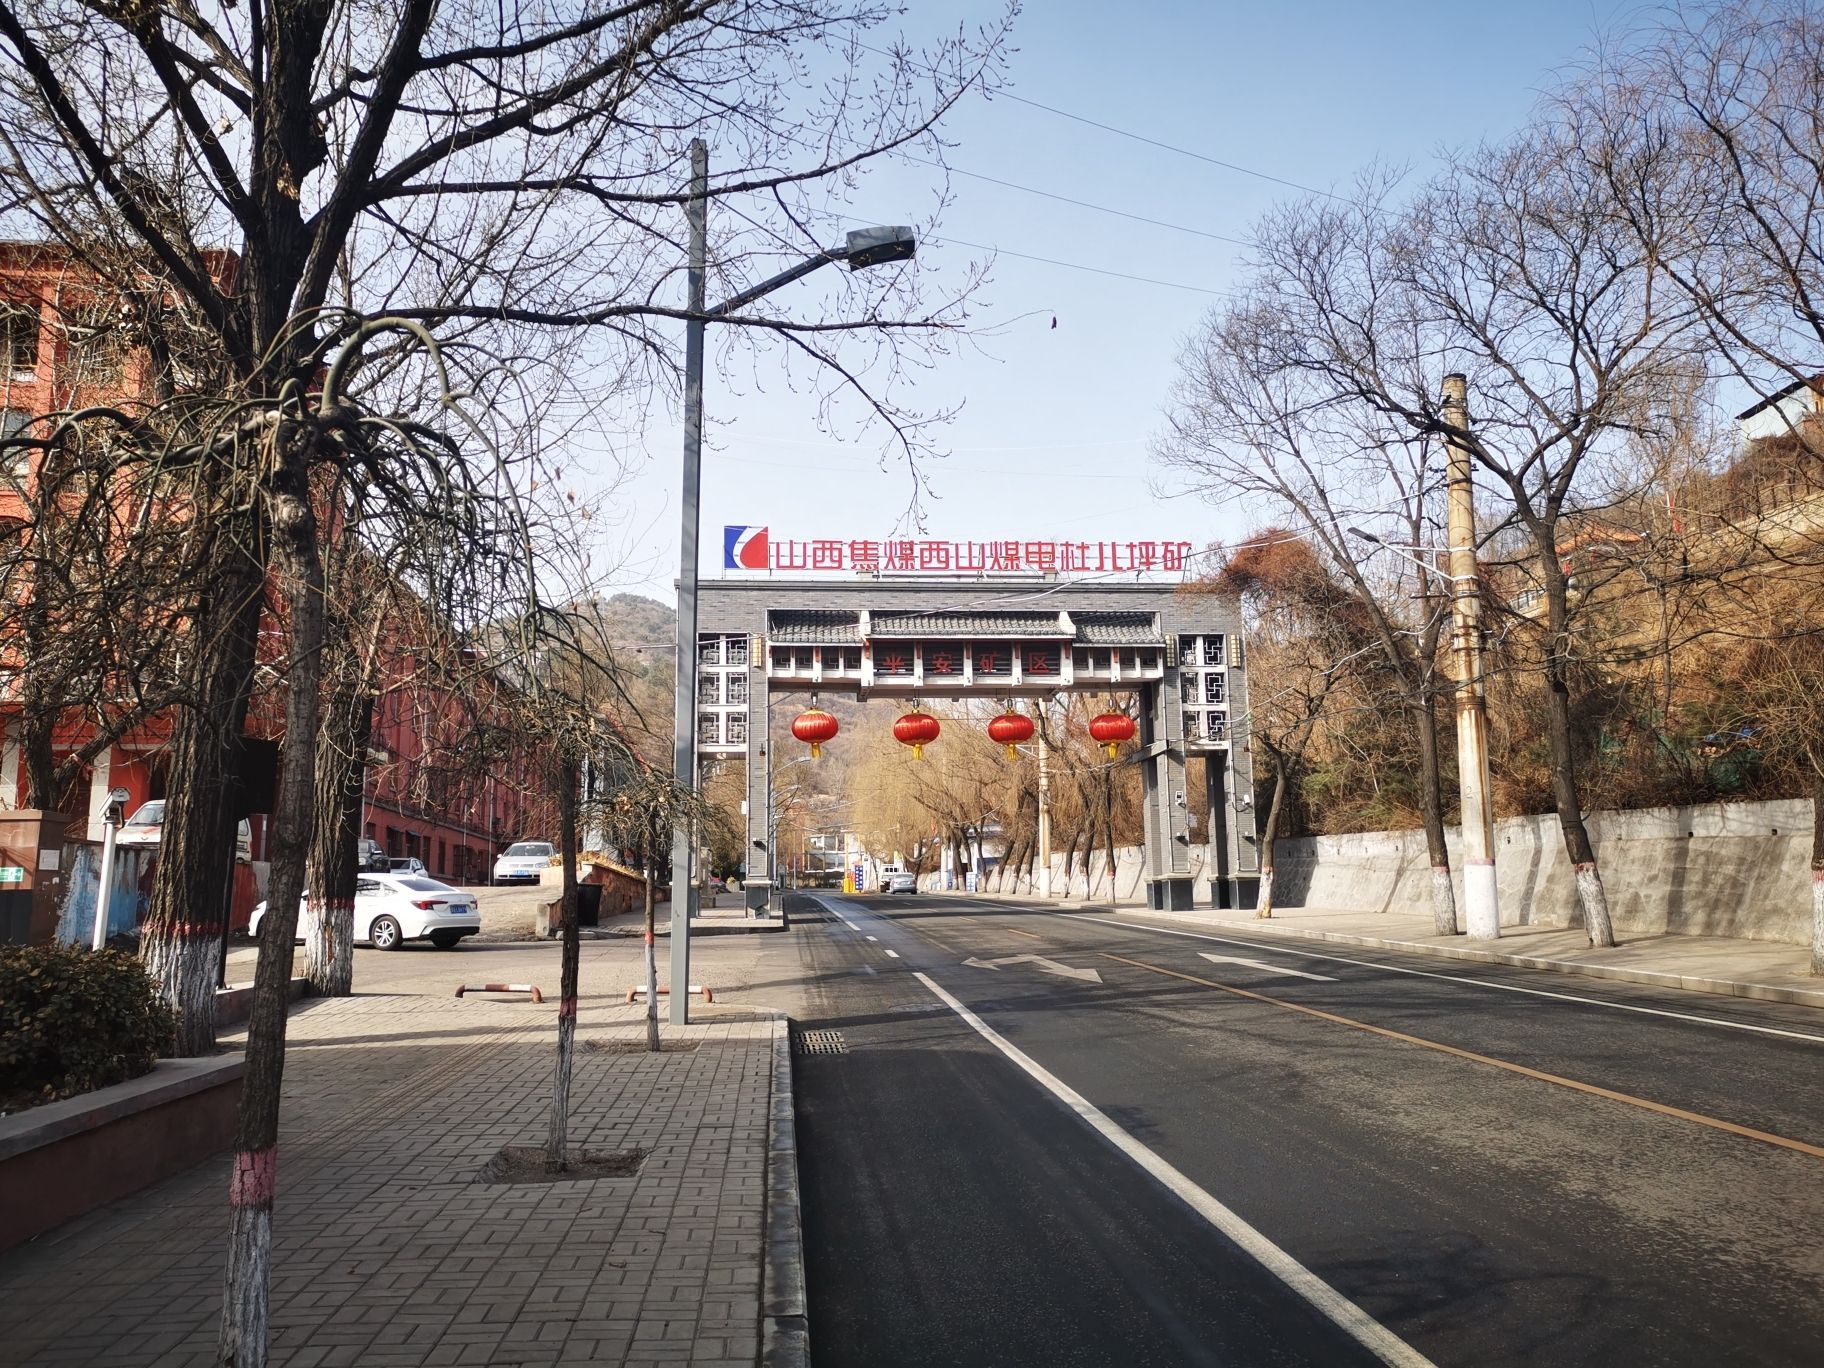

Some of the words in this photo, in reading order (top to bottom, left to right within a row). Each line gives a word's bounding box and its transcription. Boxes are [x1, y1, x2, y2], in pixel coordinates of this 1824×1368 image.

[776, 540, 1191, 571] 山西焦煤西山煤电杜儿坪矿
[882, 652, 1050, 675] 平安矿区
